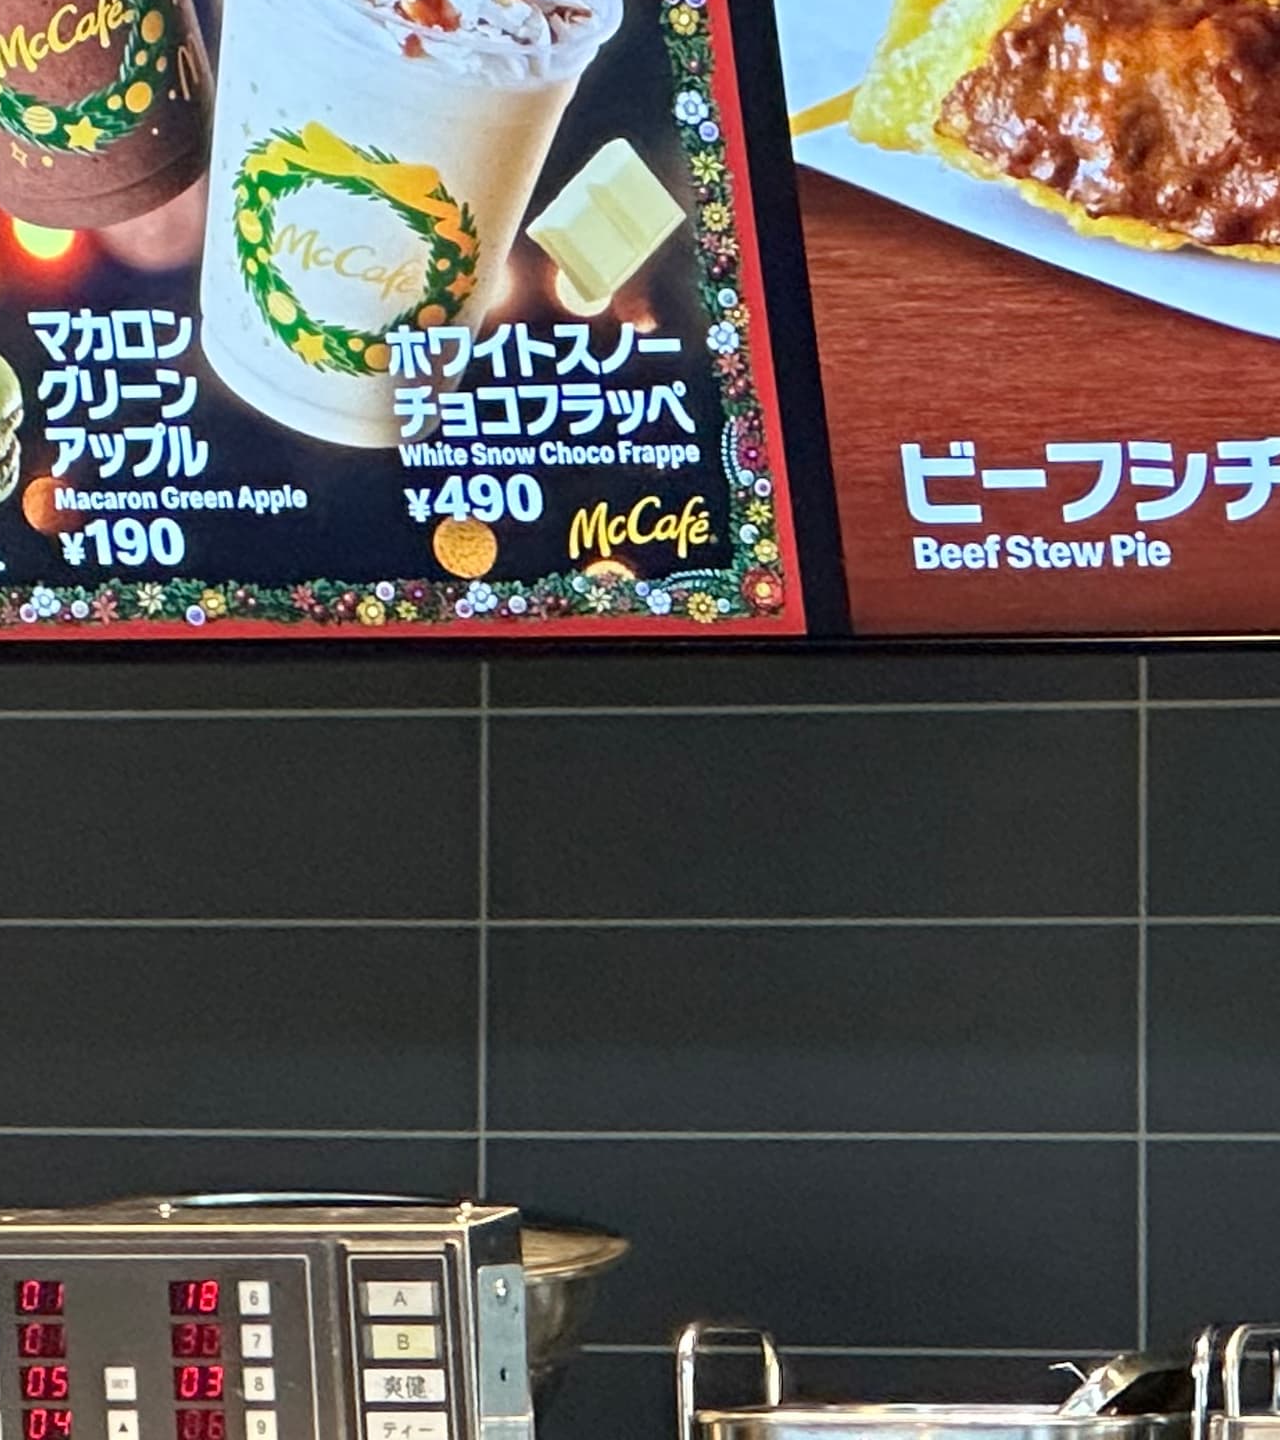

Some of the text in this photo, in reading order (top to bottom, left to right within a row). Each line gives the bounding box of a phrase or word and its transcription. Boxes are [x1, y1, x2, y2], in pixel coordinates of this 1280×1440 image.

[27, 309, 192, 361] マカロン
[386, 322, 681, 379] ホワイトスノー
[37, 367, 198, 421] グリーン
[393, 381, 696, 437] チョコフラッペ
[45, 424, 208, 478] アップル
[398, 441, 700, 469] White Snow Choco Frappe
[54, 486, 307, 515] Macaron Green Apple
[404, 474, 543, 523] ¥490
[59, 518, 185, 567] ¥190
[570, 496, 710, 559] McCafé
[913, 534, 1171, 569] Beef Stew Pie
[22, 1280, 64, 1310] 01
[187, 1281, 218, 1312] 18
[249, 1290, 259, 1306] 6
[393, 1290, 407, 1306] A
[252, 1333, 261, 1348] 7
[397, 1333, 410, 1350] B
[27, 1366, 68, 1397] 05
[181, 1366, 223, 1397] 03
[253, 1376, 264, 1391] 8
[29, 1409, 72, 1439] 04
[256, 1419, 266, 1434] 9
